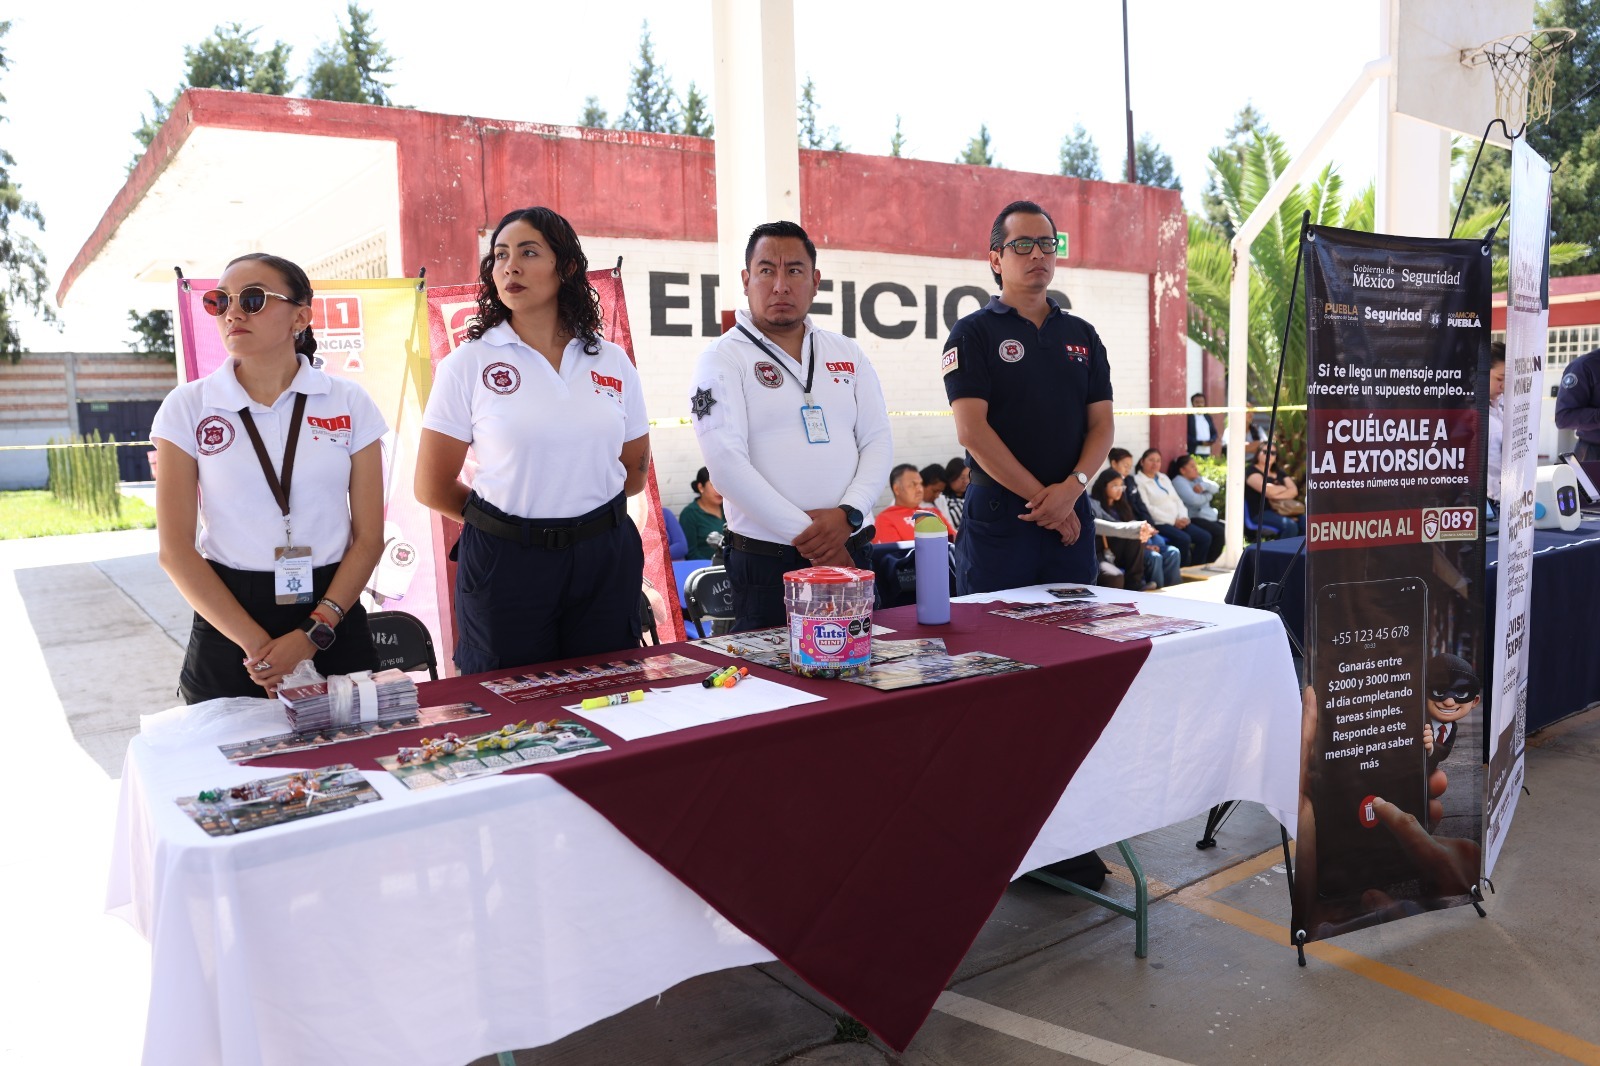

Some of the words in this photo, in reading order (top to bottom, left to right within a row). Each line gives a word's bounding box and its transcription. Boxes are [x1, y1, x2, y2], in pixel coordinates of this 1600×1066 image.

[1353, 264, 1385, 274] Gobierno
[1386, 266, 1395, 274] de
[1401, 268, 1461, 286] Seguridad
[1352, 273, 1395, 289] México
[1324, 302, 1359, 316] PUEBLA
[1364, 306, 1423, 323] Seguridad
[1455, 311, 1475, 319] AMOR
[1447, 318, 1482, 328] PUEBLA
[1317, 363, 1330, 378] Si
[1333, 365, 1346, 378] te
[1349, 364, 1371, 381] llega
[1374, 368, 1387, 379] un
[1389, 366, 1433, 382] mensaje
[1435, 368, 1462, 382] para
[1361, 384, 1373, 395] un
[1375, 383, 1420, 398] supuesto
[1423, 382, 1475, 398] empleo...
[309, 416, 349, 430] 911
[1326, 413, 1430, 444] ¡CUÉLGALE
[1434, 418, 1448, 441] A
[1311, 450, 1337, 474] LA
[1343, 442, 1466, 474] EXTORSIÓN!
[1319, 478, 1365, 490] contestes
[1366, 477, 1399, 488] números
[1400, 478, 1416, 489] que
[1417, 477, 1428, 486] no
[1430, 475, 1469, 485] conoces
[1440, 510, 1474, 529] 089
[1310, 518, 1392, 543] DENUNCIA
[1395, 516, 1414, 537] AL
[813, 625, 847, 639] Tutsi
[1331, 631, 1351, 646] +55
[1354, 629, 1373, 643] 123
[1375, 627, 1389, 640] 45
[1391, 625, 1410, 639] 678
[1338, 658, 1375, 674] Ganarás
[1377, 656, 1403, 668] entre
[1328, 677, 1357, 693] $2000
[1358, 679, 1364, 690] y
[1365, 673, 1389, 687] 3000
[1390, 672, 1411, 684] mxn
[1325, 697, 1335, 709] al
[1336, 694, 1351, 707] día
[1352, 687, 1413, 706] completando
[1336, 712, 1364, 725] tareas
[1365, 706, 1403, 722] simples.
[1332, 726, 1378, 744] Responde
[1379, 726, 1386, 735] a
[1386, 721, 1407, 733] este
[1325, 743, 1364, 761] mensaje
[1365, 741, 1387, 756] para
[1387, 736, 1414, 750] saber
[1360, 757, 1380, 771] más
